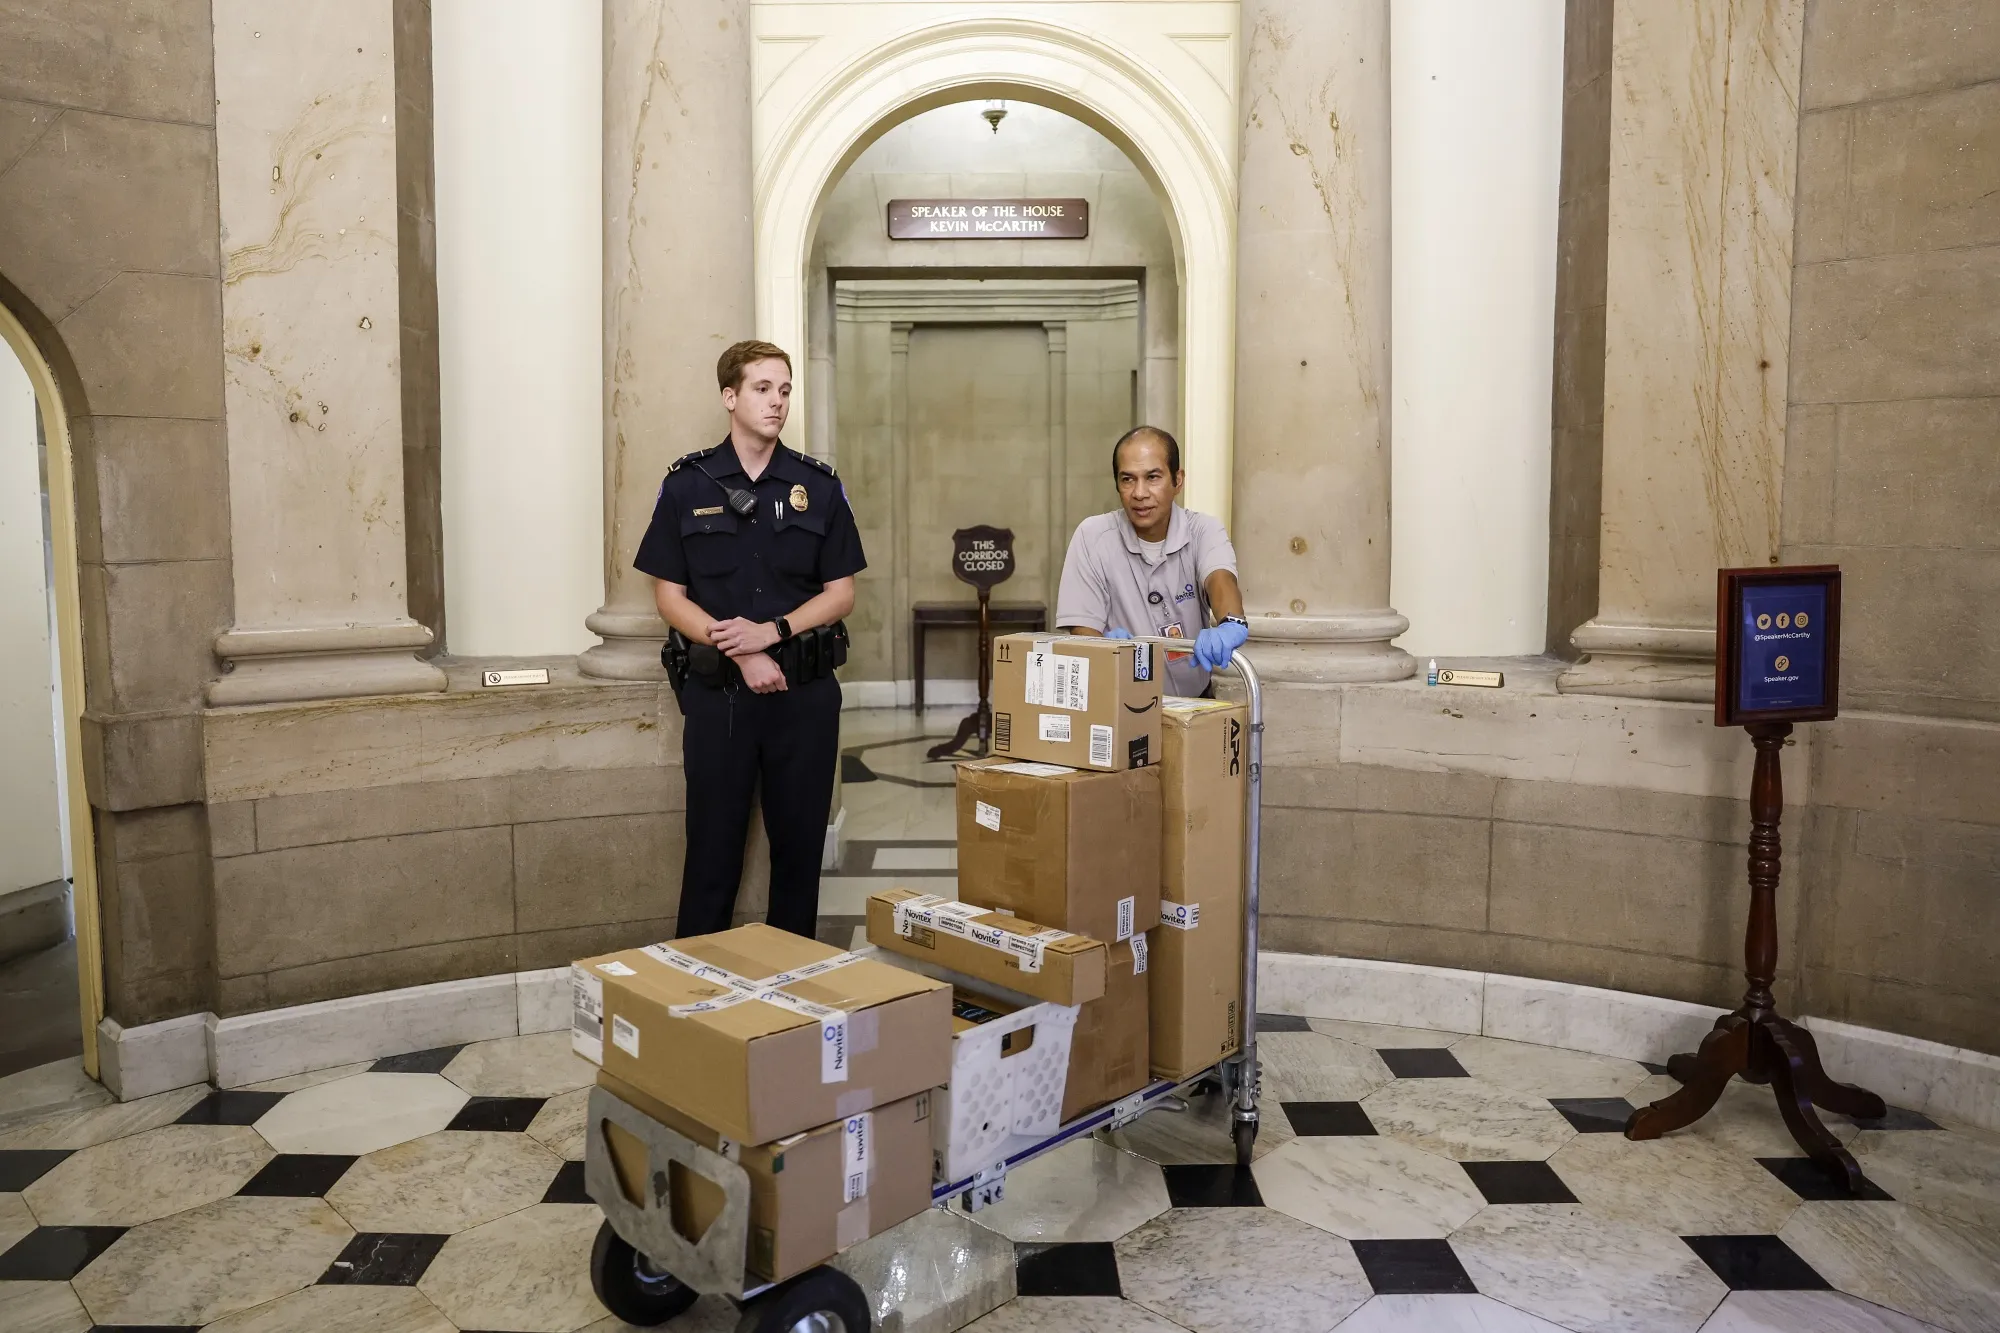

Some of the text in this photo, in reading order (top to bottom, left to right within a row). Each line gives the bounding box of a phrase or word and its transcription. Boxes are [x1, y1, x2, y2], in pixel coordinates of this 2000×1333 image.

[911, 205, 1064, 218] SPEAKER OF THE HOUSE
[930, 220, 1046, 232] KEVIN McCARTHY
[972, 540, 995, 550] THIS
[959, 550, 1009, 561] CORRIDOR
[964, 560, 1005, 571] CLOSED
[1754, 631, 1811, 642] @SpeakerMcCarthy
[1764, 675, 1799, 683] Speaker.gov
[1230, 717, 1240, 776] APC
[905, 908, 931, 924] Novitex
[972, 928, 1000, 945] Novitex
[834, 1024, 843, 1070] Novitex
[856, 1116, 864, 1162] Novitex
